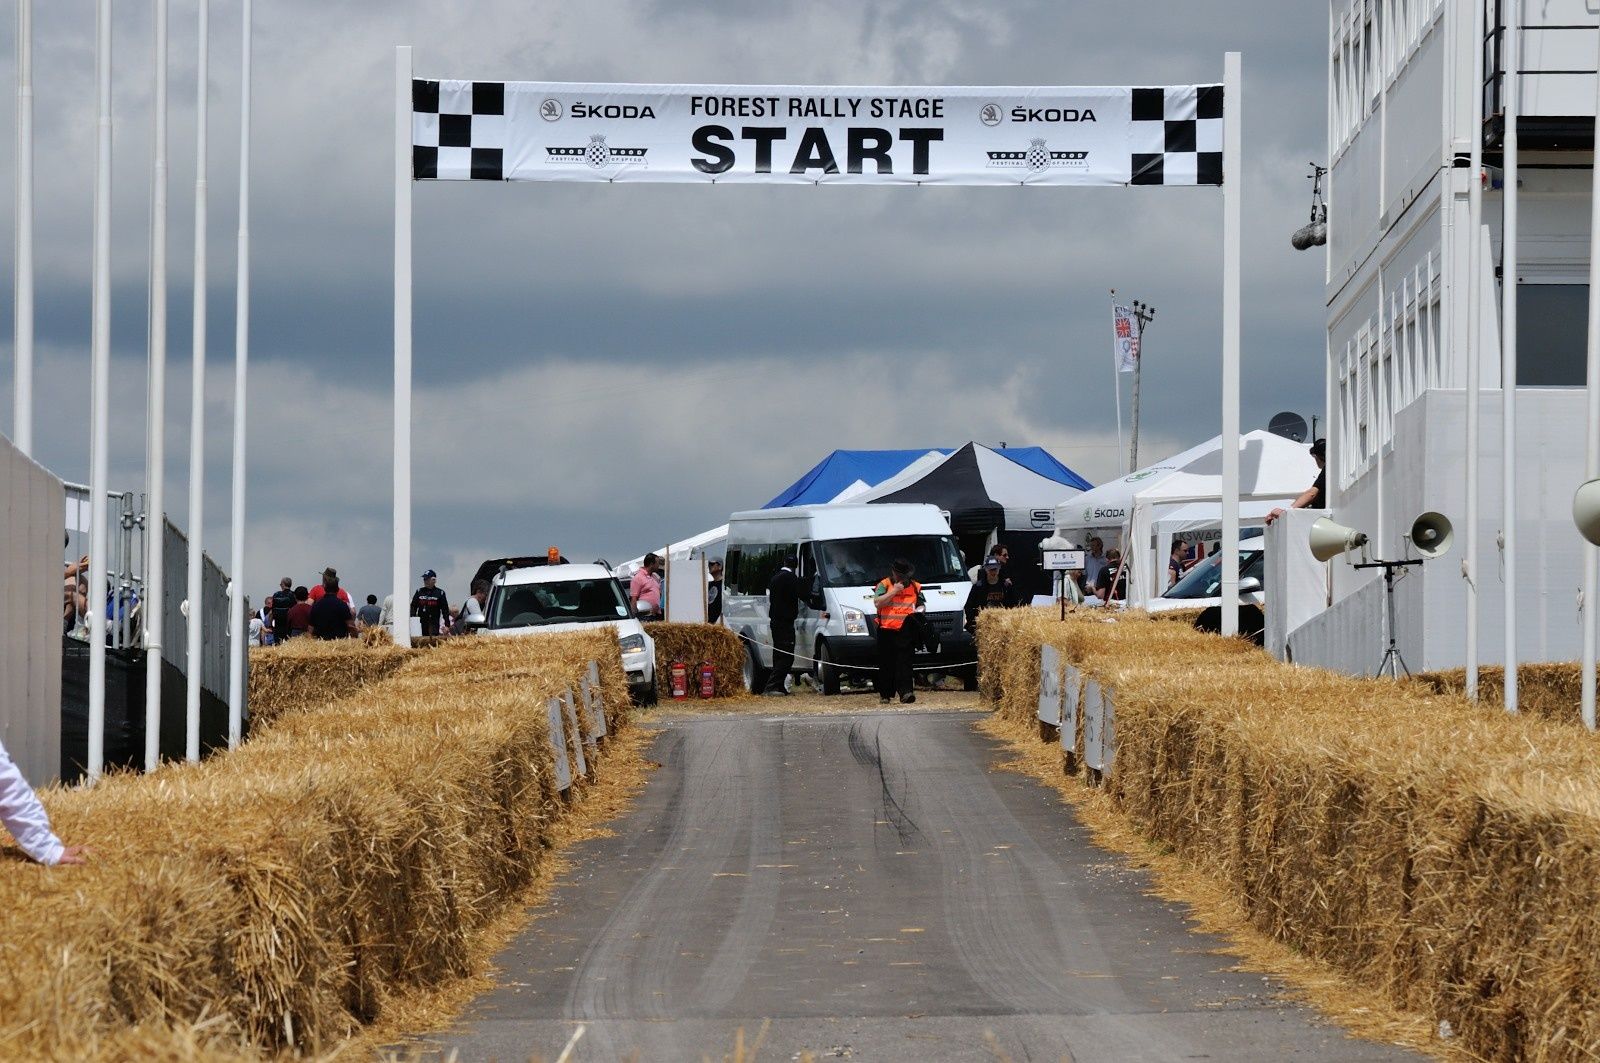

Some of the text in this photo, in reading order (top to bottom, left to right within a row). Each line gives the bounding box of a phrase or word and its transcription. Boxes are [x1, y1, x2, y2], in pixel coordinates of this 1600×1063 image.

[571, 101, 656, 119] ŠKODA
[691, 96, 944, 118] FOREST RALLY STAGE
[1011, 105, 1097, 122] ŠKODA
[690, 124, 944, 175] START
[1094, 508, 1125, 518] ŠKODA
